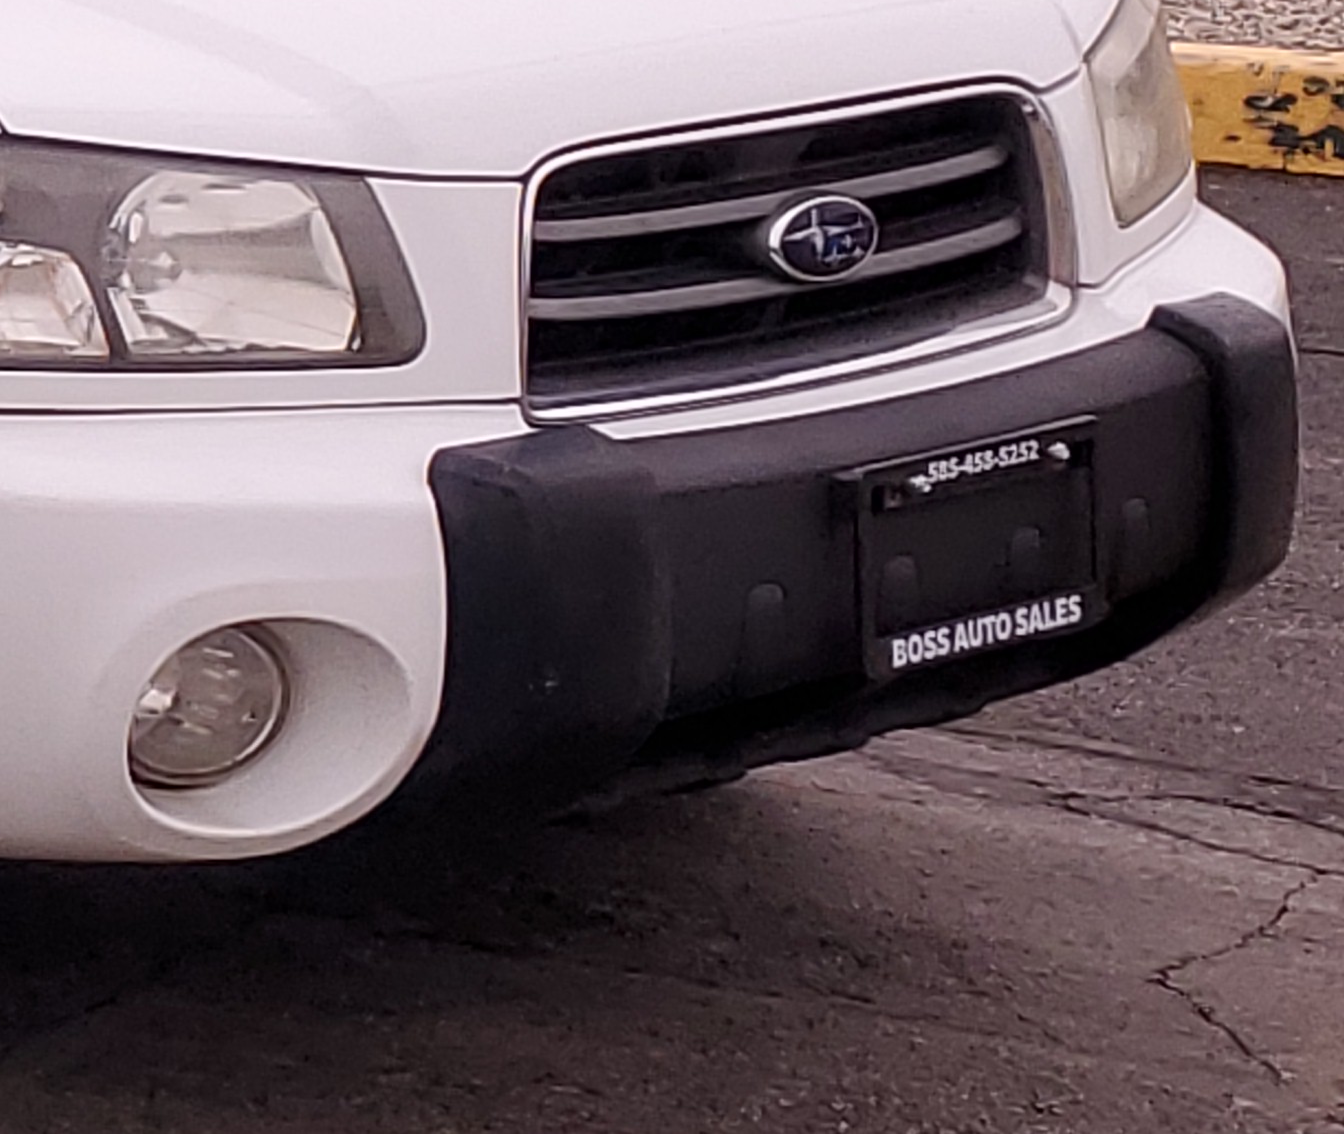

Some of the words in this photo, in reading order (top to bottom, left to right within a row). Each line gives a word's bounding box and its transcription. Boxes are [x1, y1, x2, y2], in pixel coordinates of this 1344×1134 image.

[891, 626, 951, 669] BOSS
[953, 611, 1012, 653] AUTO
[1014, 594, 1082, 636] SALES
